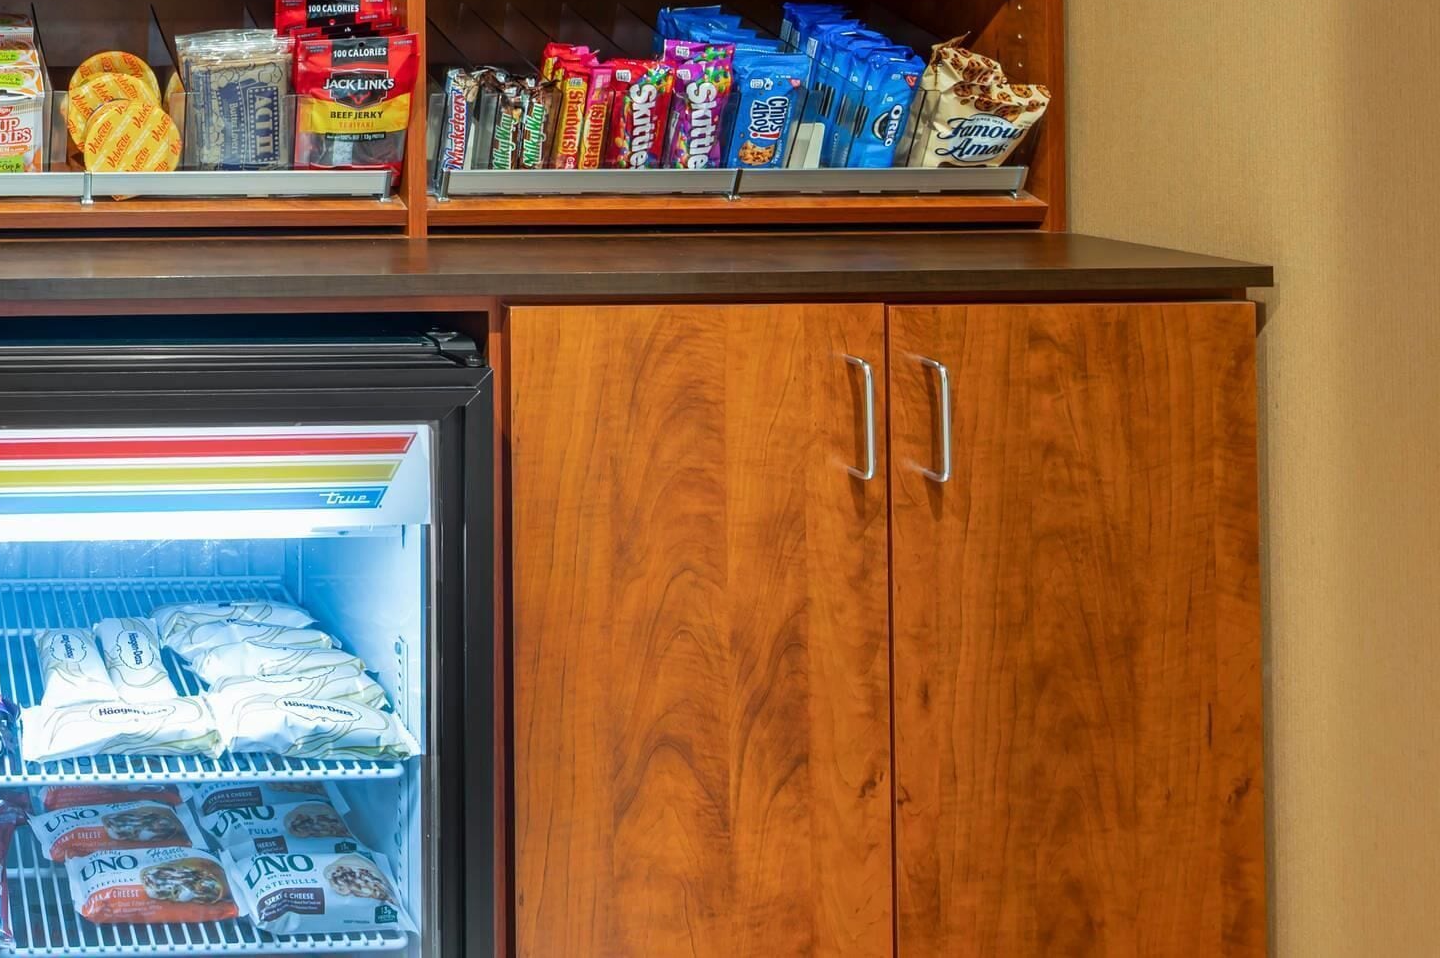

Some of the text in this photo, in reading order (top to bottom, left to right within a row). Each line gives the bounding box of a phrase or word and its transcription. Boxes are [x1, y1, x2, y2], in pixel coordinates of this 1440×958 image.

[322, 3, 360, 12] CALORIES
[333, 47, 387, 58] 100 CALORIES
[323, 78, 355, 91] JACK
[330, 111, 384, 119] BEEF JERKY
[687, 82, 717, 169] Skittle
[884, 104, 903, 147] OREO
[88, 120, 113, 155] Velveeta
[937, 118, 1024, 140] Famous
[107, 134, 131, 168] Velveeta
[935, 138, 1008, 159] Amos
[319, 492, 370, 505] true
[283, 700, 354, 718] Häagen-Dazs
[44, 809, 100, 833] UNO
[80, 854, 138, 882] UNO
[244, 854, 314, 890] UNO
[112, 890, 140, 898] CHEESE
[290, 892, 315, 900] CHEESE
